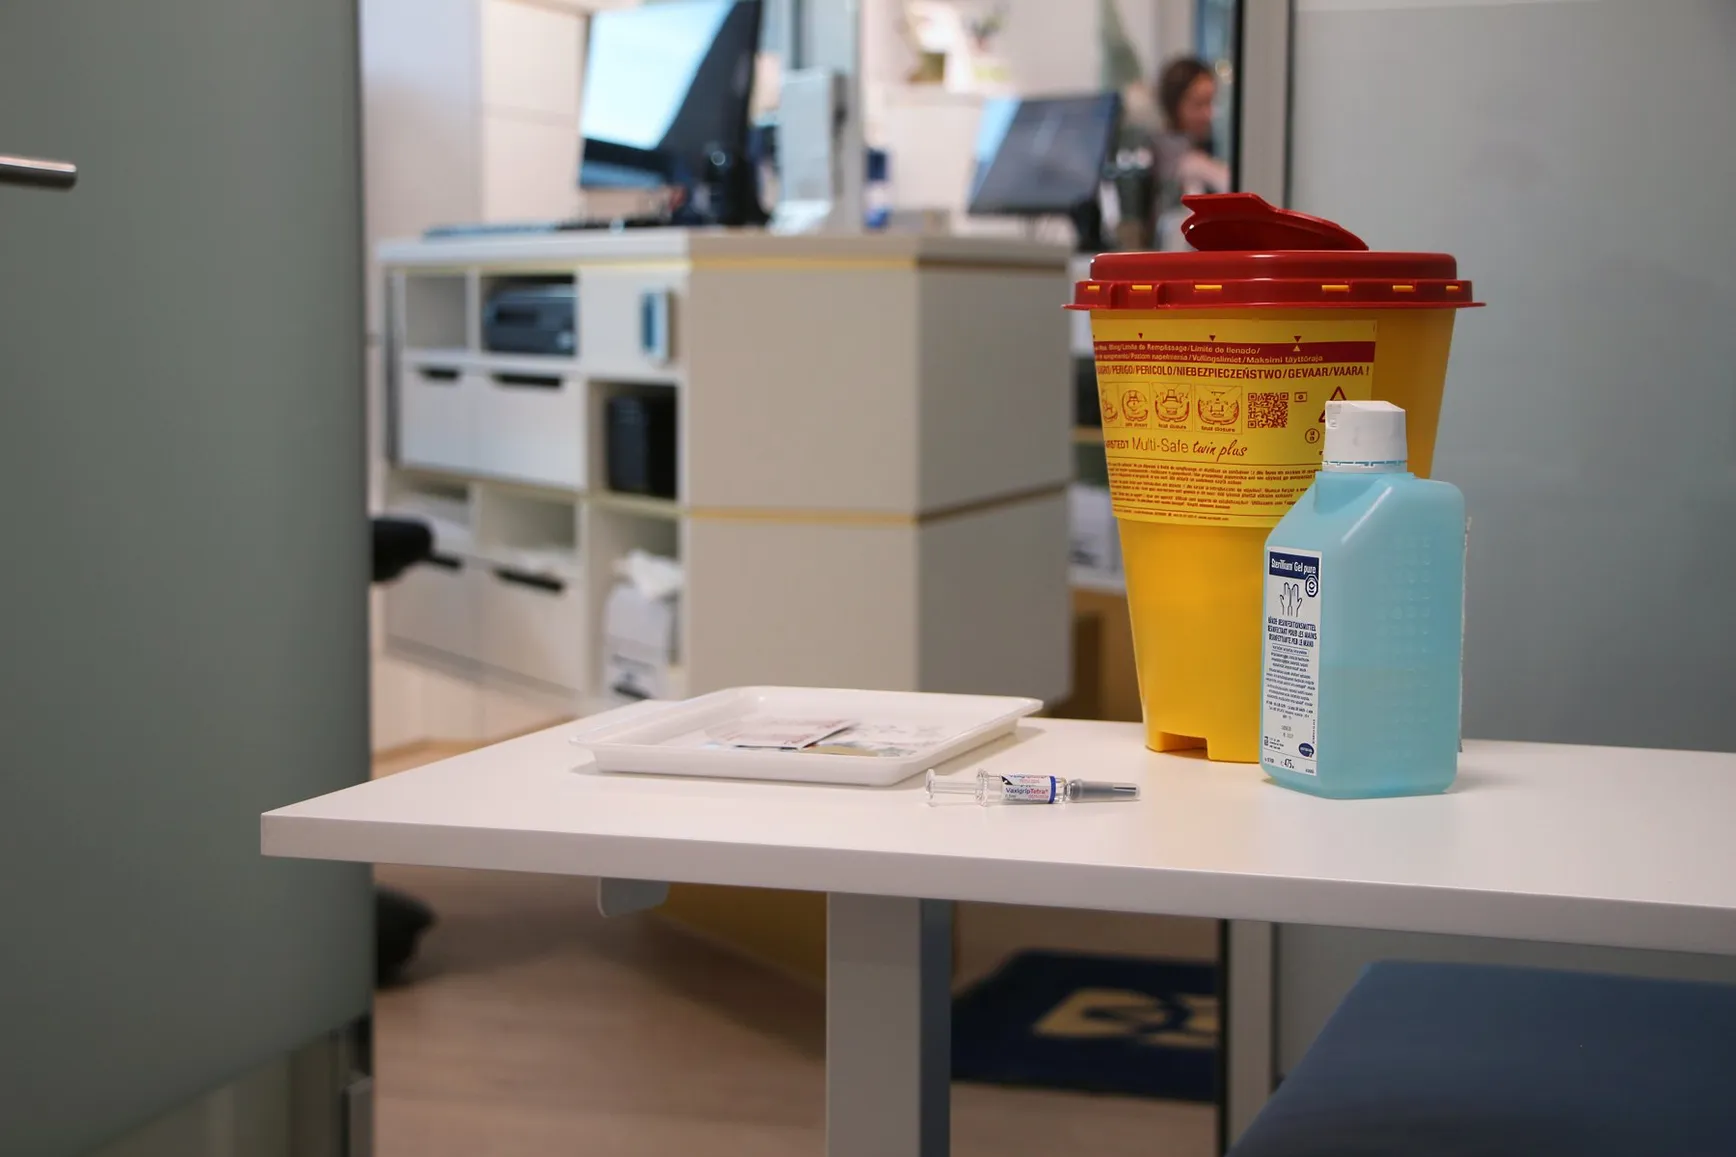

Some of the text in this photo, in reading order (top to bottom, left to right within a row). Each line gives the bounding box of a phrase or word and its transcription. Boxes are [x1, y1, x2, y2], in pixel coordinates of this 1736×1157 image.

[1132, 437, 1189, 454] Multi-Safe
[1192, 441, 1217, 456] twin
[1216, 439, 1248, 462] plus
[1294, 561, 1303, 572] Gel
[1303, 565, 1317, 575] pure
